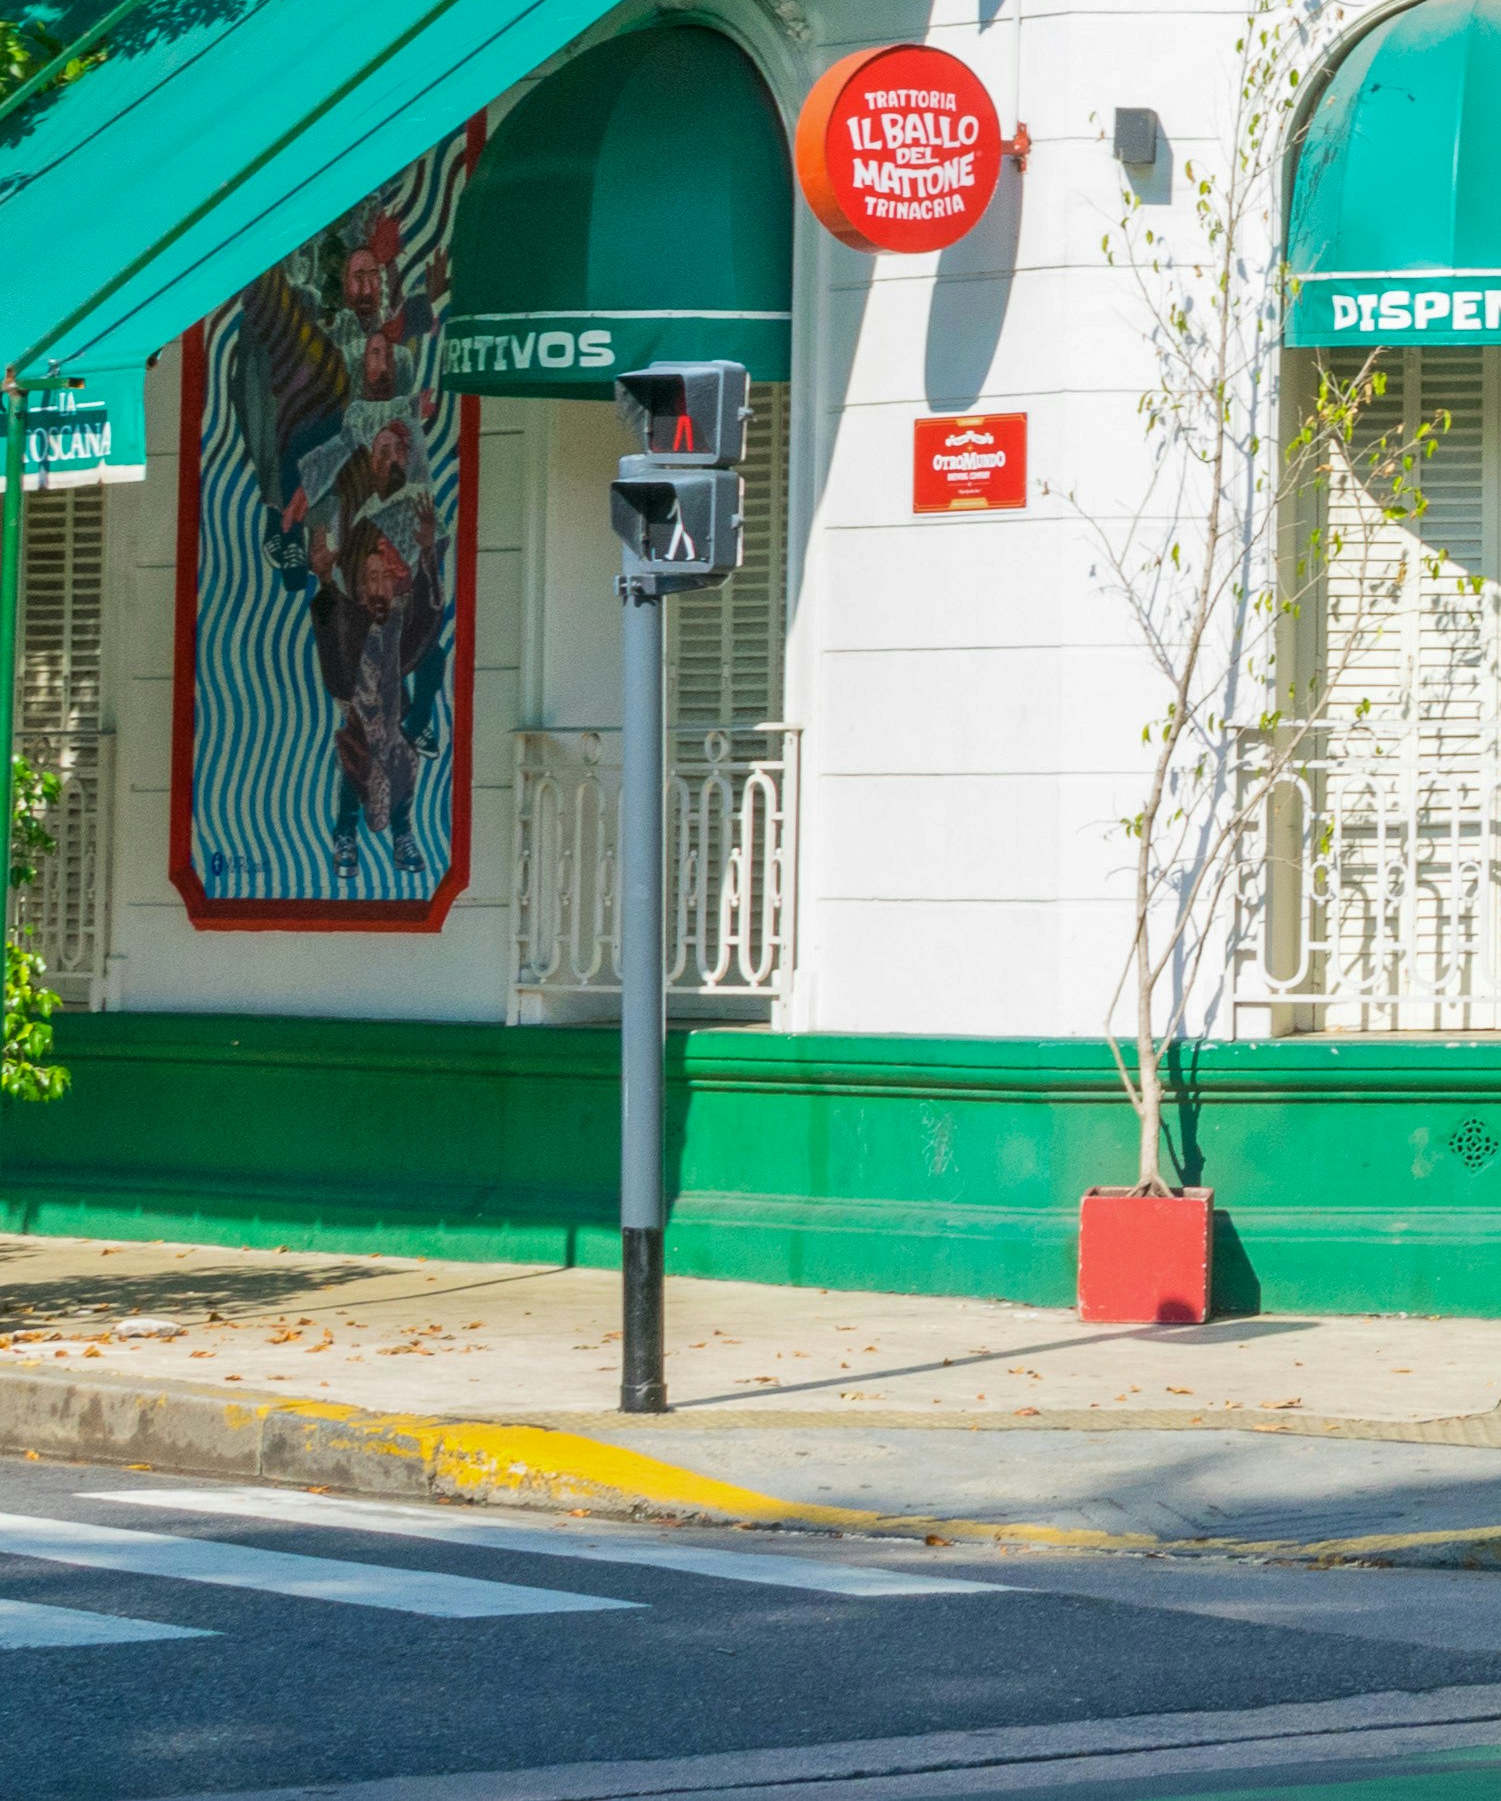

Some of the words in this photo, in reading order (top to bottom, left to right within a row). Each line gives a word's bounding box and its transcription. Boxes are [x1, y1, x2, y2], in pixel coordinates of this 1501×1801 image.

[864, 89, 957, 112] TRATTORIA
[847, 116, 883, 151] IL
[881, 112, 980, 149] BALLO
[895, 146, 939, 165] DEL
[852, 152, 976, 198] MATTONE
[864, 194, 966, 221] TRINACRIA
[59, 392, 77, 416] LA
